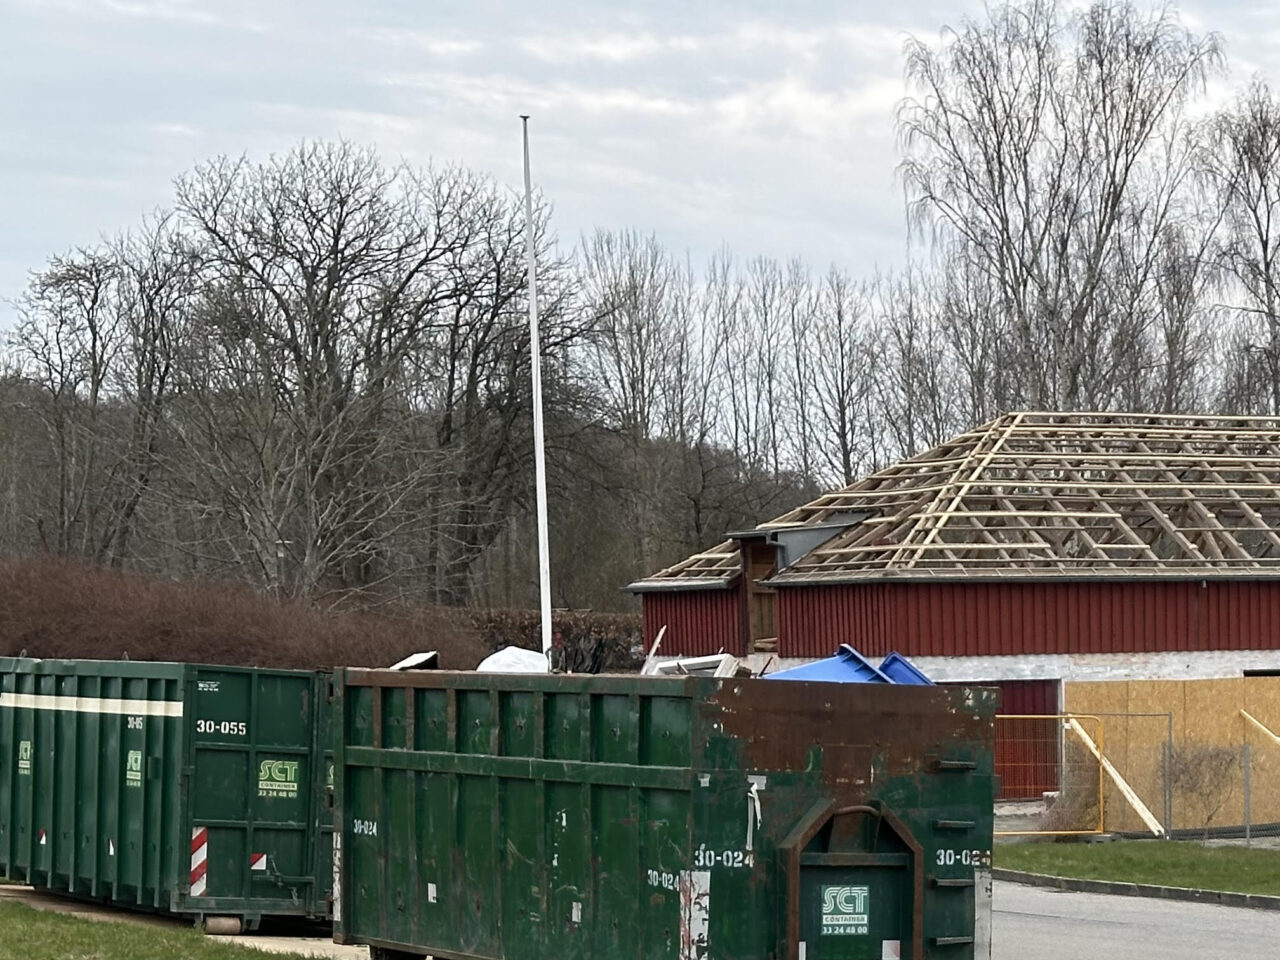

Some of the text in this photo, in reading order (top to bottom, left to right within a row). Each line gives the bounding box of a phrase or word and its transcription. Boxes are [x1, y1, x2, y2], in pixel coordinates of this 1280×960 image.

[196, 719, 247, 736] 30-055
[259, 760, 299, 781] SCT
[694, 850, 755, 868] 30-024
[647, 869, 680, 892] 30-024
[822, 886, 868, 913] SCT
[857, 926, 868, 934] 00
